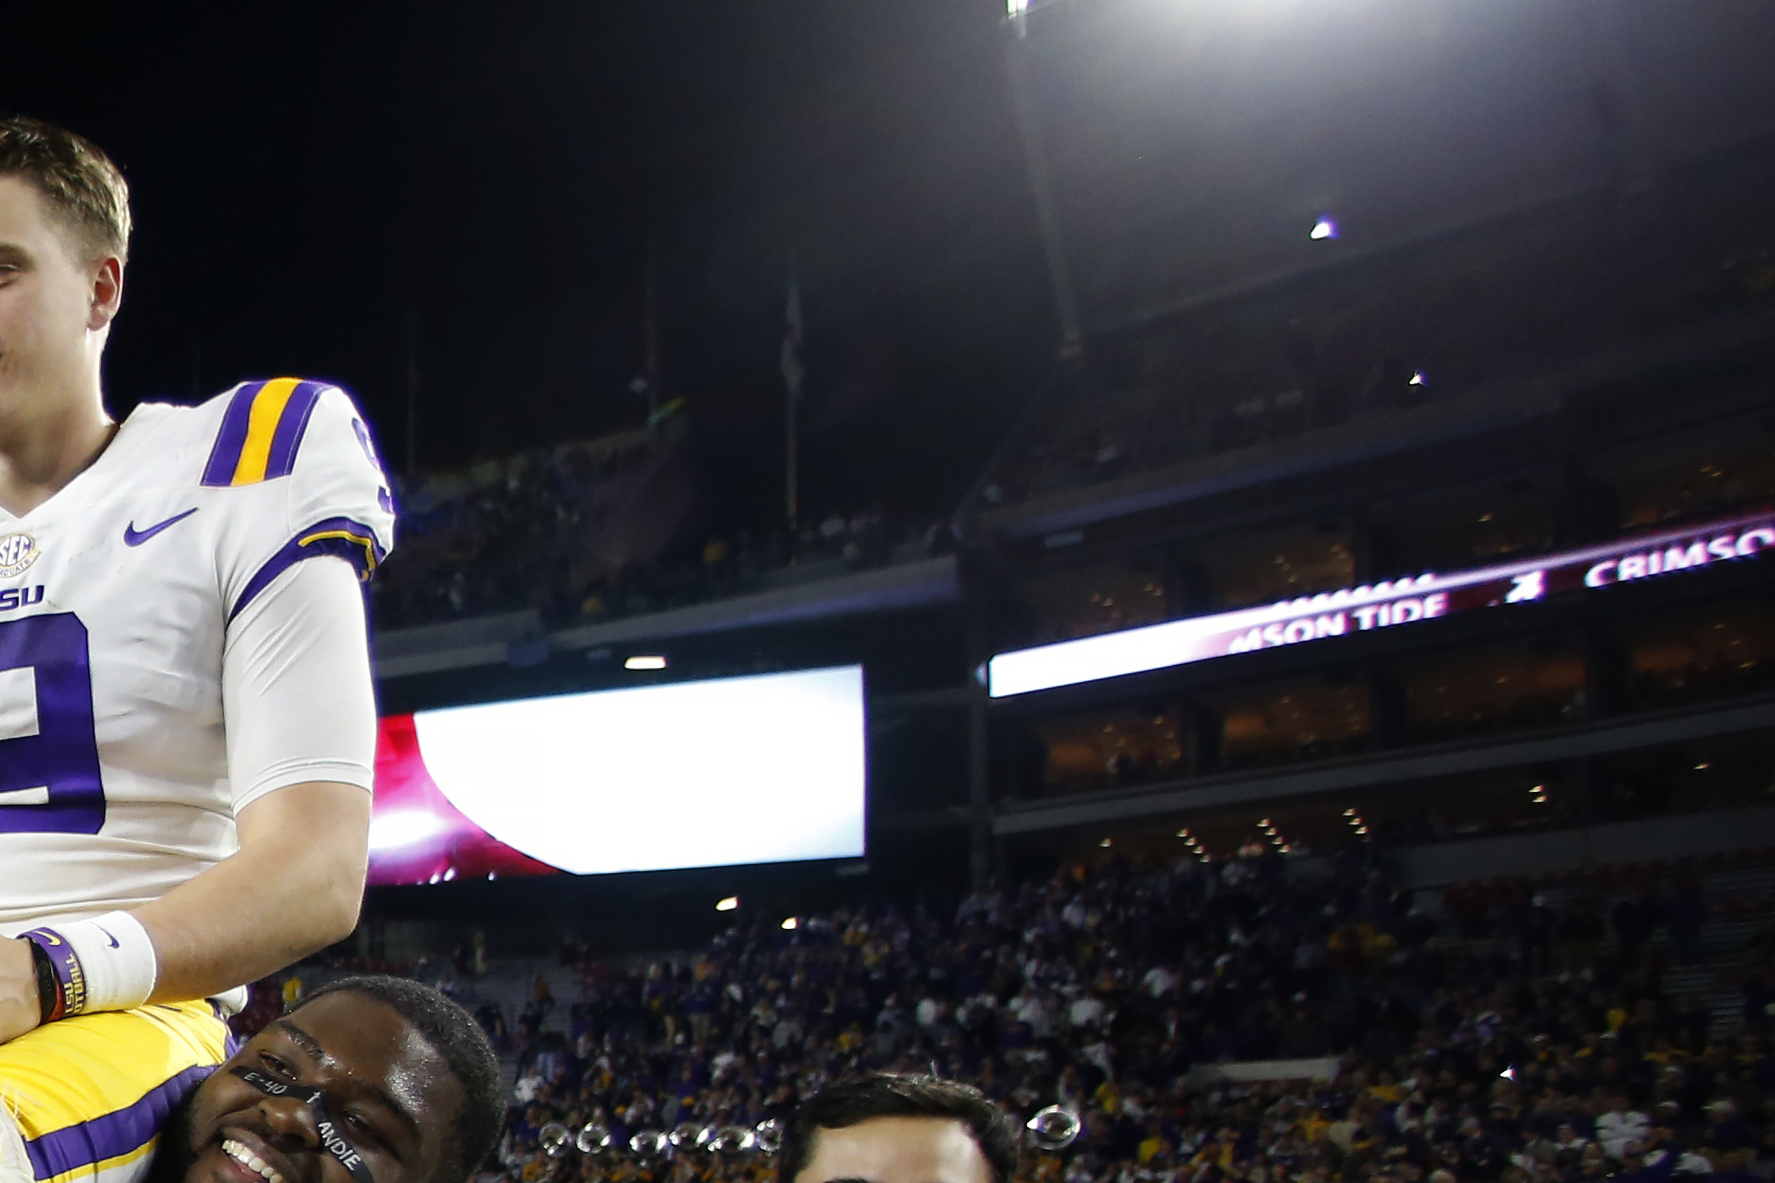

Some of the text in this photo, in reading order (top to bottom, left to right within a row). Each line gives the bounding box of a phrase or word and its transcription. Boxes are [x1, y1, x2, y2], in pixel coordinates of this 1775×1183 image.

[1353, 591, 1451, 631] TIDE
[243, 1071, 288, 1095] E-40
[317, 1121, 362, 1172] ANDIE
